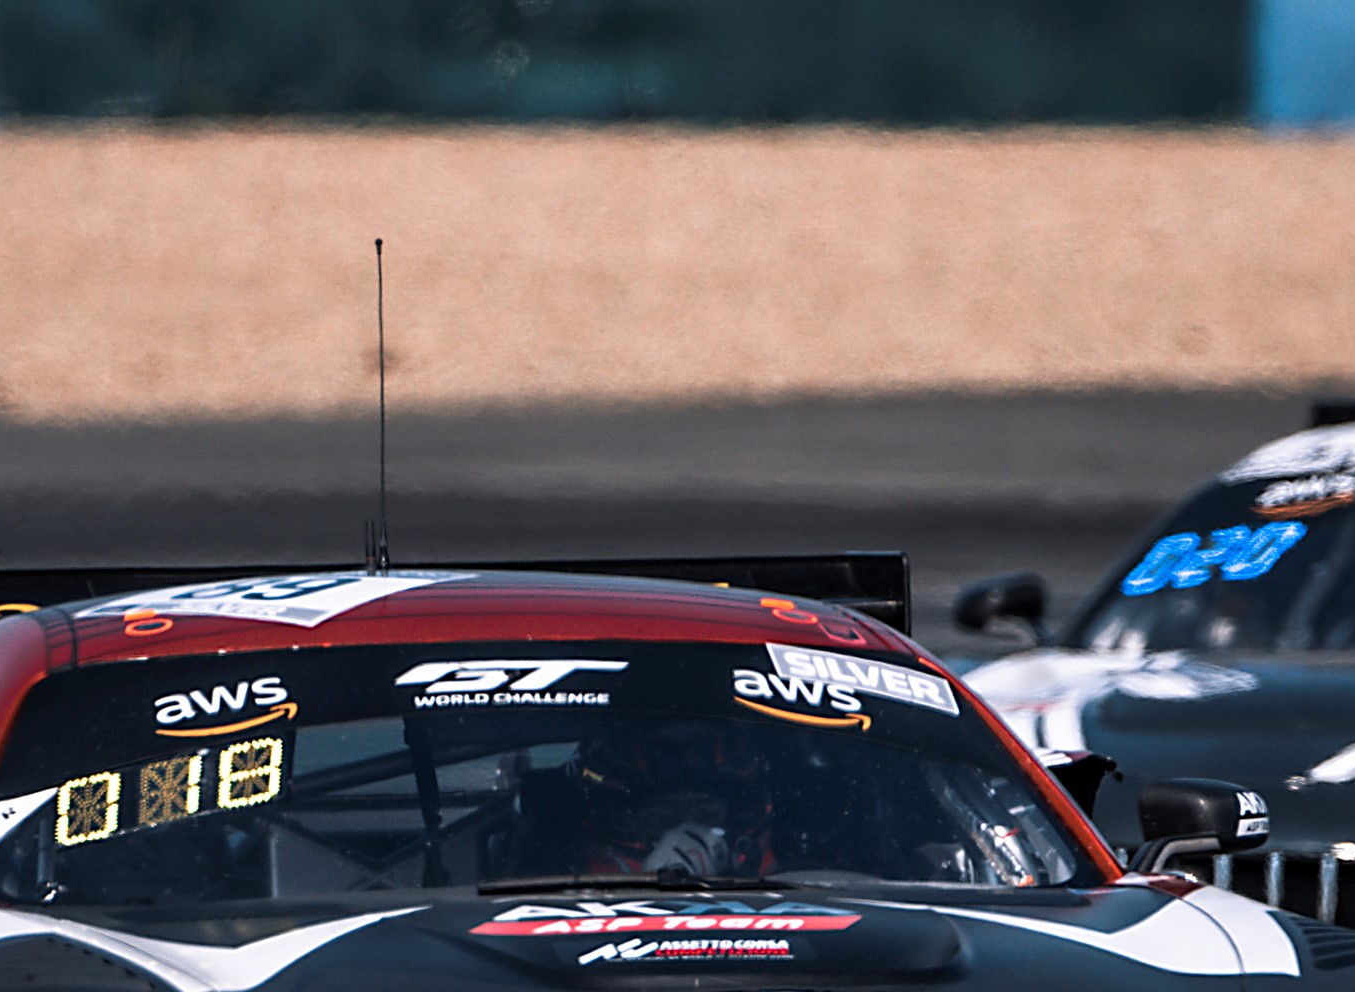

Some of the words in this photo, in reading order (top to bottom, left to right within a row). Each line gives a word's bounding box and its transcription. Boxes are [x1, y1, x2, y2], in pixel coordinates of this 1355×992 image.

[394, 659, 631, 693] GT
[733, 669, 862, 712] aws
[784, 651, 946, 704] SILVER
[154, 677, 289, 724] aws
[414, 692, 490, 708] WORLD
[494, 692, 612, 706] CHALLENGE
[56, 737, 284, 846] 018
[533, 908, 643, 933] ASP
[662, 906, 806, 930] Team
[659, 940, 733, 951] ASSETTO
[733, 940, 790, 949] CORSA
